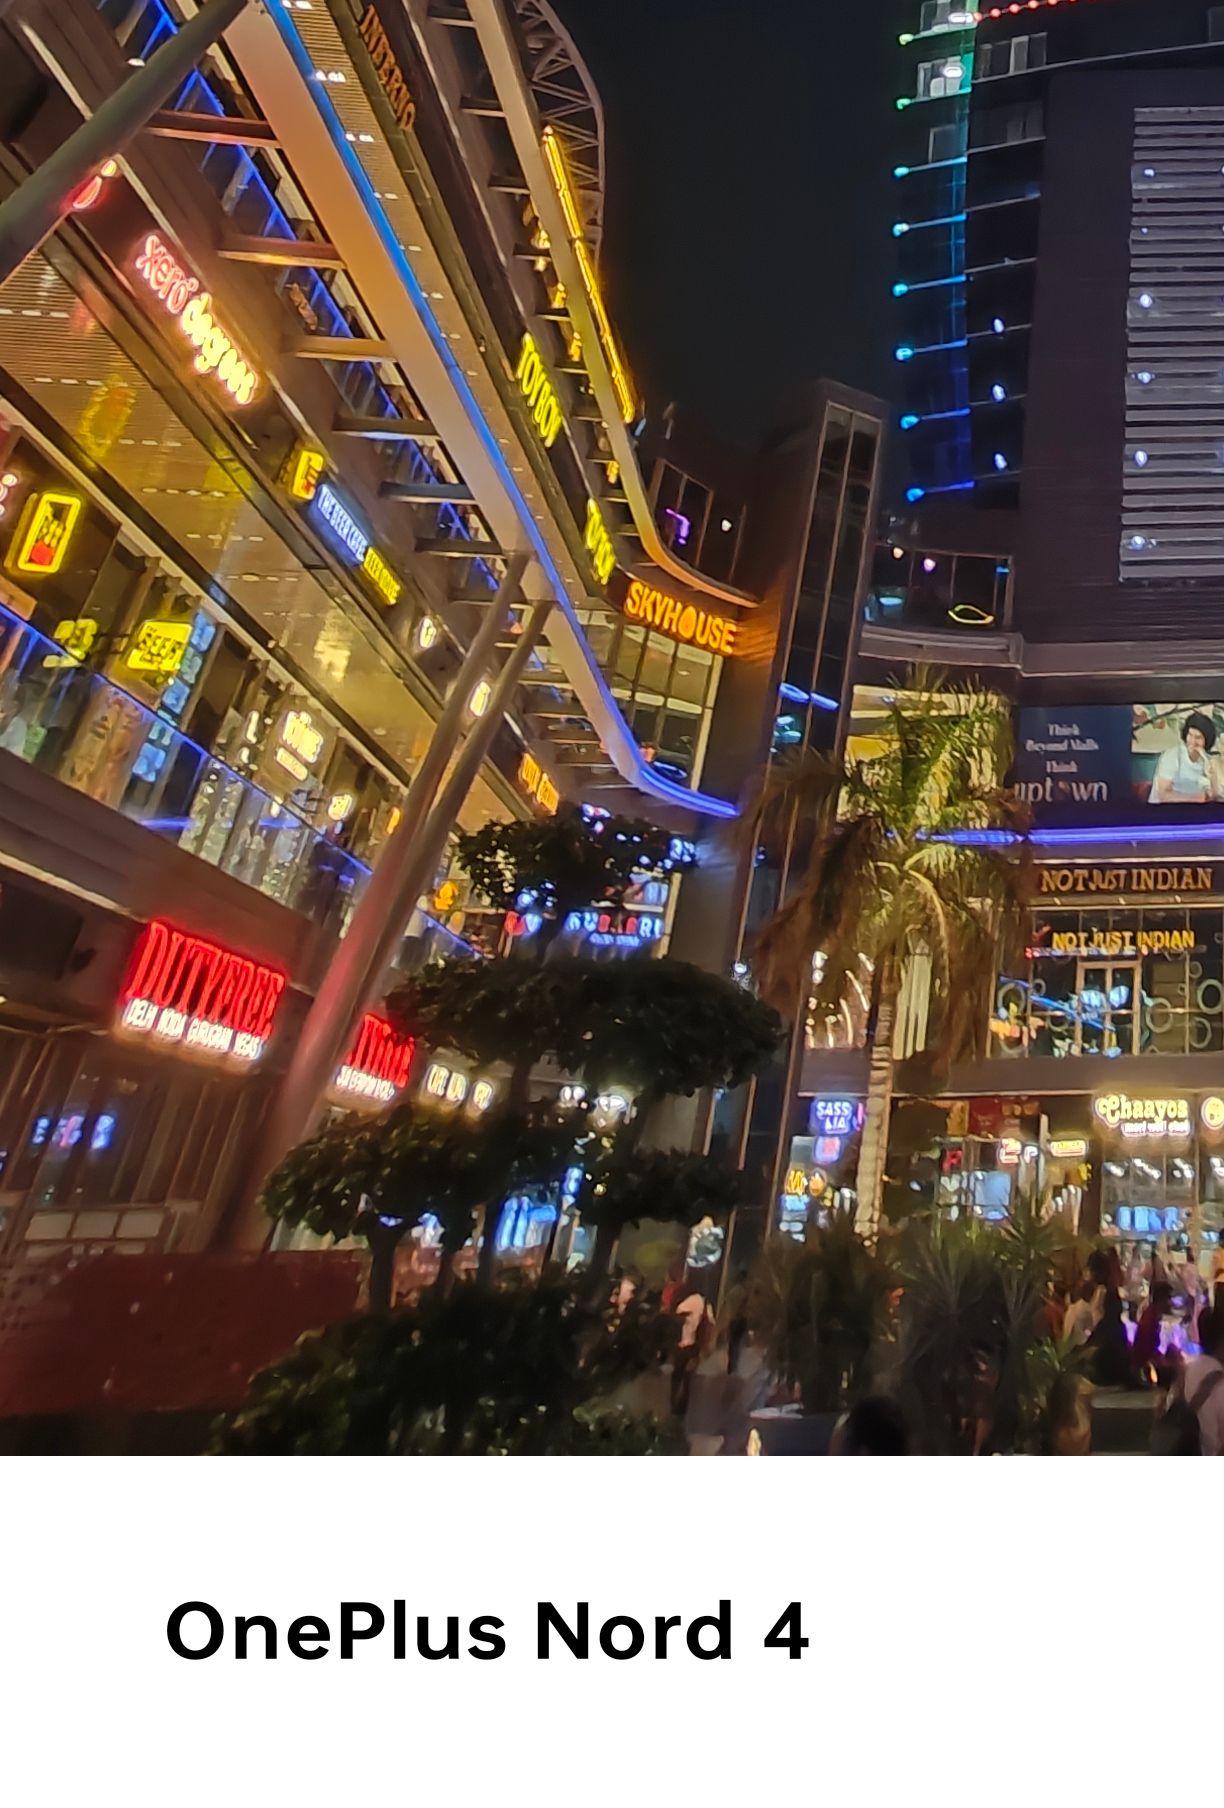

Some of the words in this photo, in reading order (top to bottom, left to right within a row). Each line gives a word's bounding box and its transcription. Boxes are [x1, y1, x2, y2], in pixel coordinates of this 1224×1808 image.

[517, 332, 562, 447] TOYBOY
[1041, 869, 1088, 892] NOT
[1089, 869, 1127, 891] JUST
[1131, 867, 1213, 891] INDIAN
[1052, 931, 1088, 952] NOT
[1091, 930, 1134, 951] JUST
[1137, 929, 1195, 950] INDIAN
[1097, 1095, 1188, 1124] Chaayos
